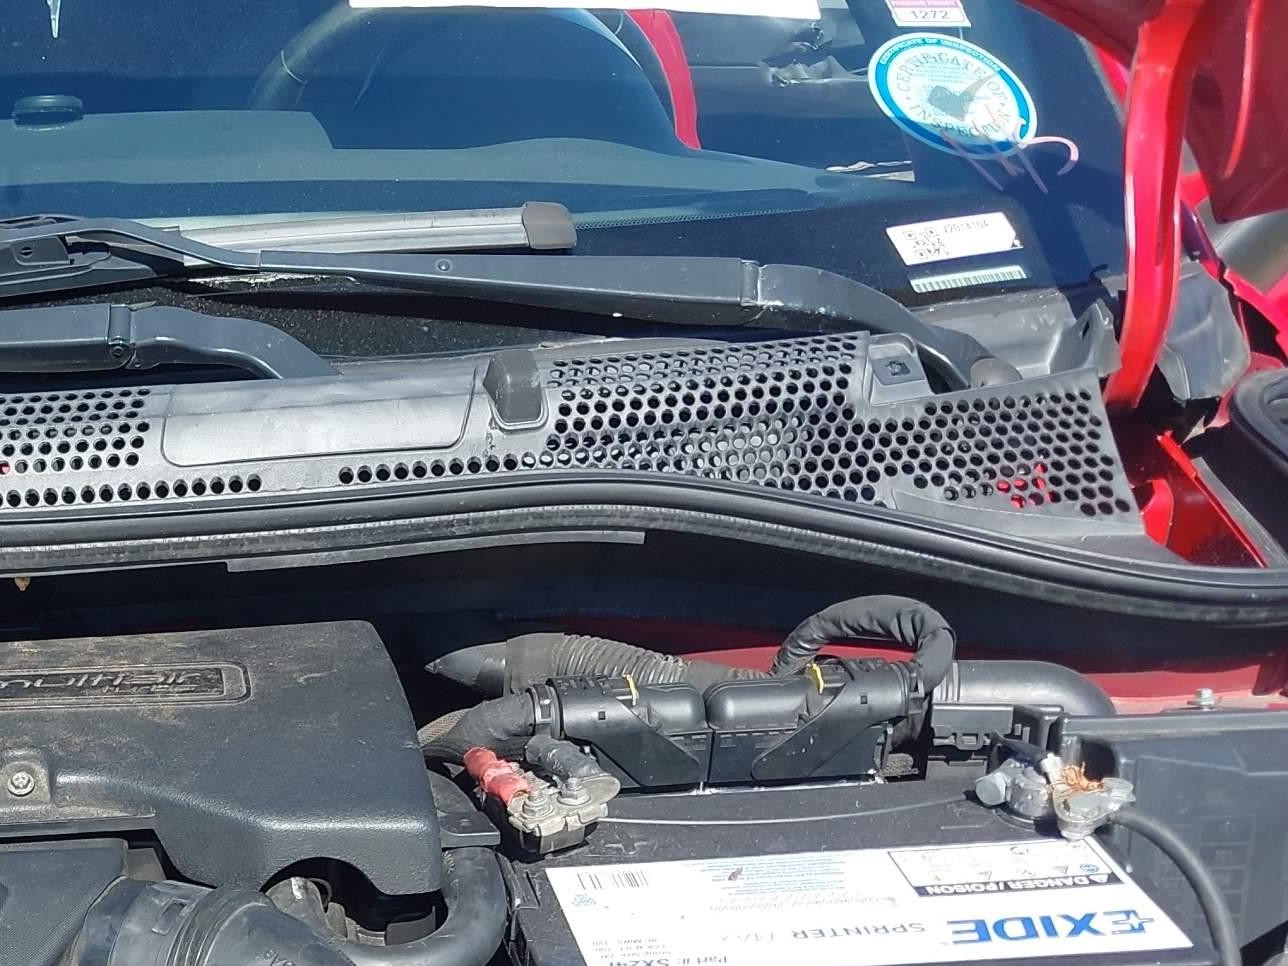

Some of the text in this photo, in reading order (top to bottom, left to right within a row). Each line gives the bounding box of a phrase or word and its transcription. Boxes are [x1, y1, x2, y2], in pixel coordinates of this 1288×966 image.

[910, 10, 950, 19] 1272
[925, 882, 996, 895] POISON
[1007, 876, 1089, 889] DANGER
[791, 921, 927, 941] SPRINTER
[946, 909, 1156, 945] EXIDE
[696, 955, 728, 966] Part
